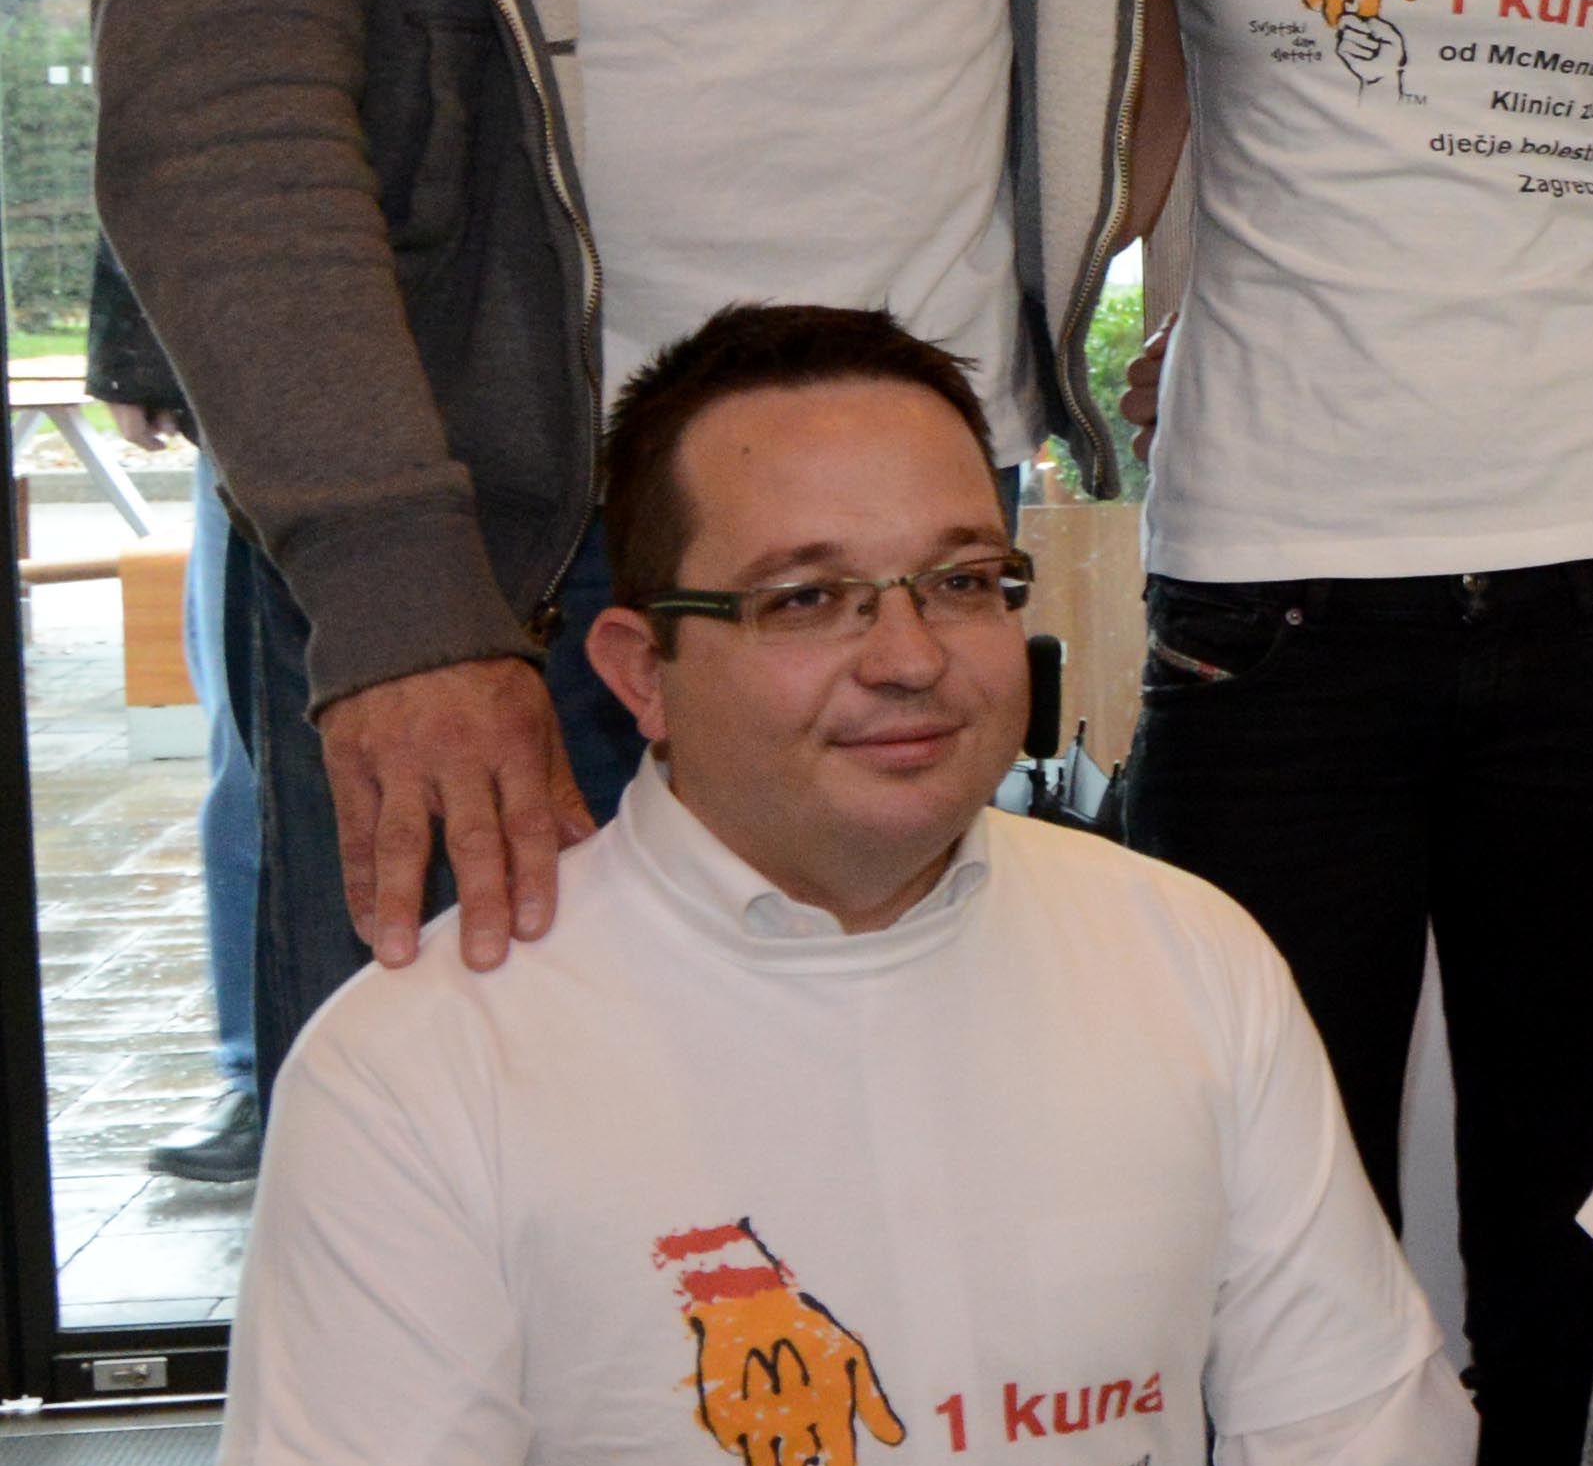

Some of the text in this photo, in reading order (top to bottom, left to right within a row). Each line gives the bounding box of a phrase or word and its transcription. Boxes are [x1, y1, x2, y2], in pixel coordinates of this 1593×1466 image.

[1440, 43, 1477, 62] od
[1490, 90, 1575, 118] Klinici
[1430, 133, 1512, 157] dječje
[935, 1371, 1164, 1452] 1 kuna
